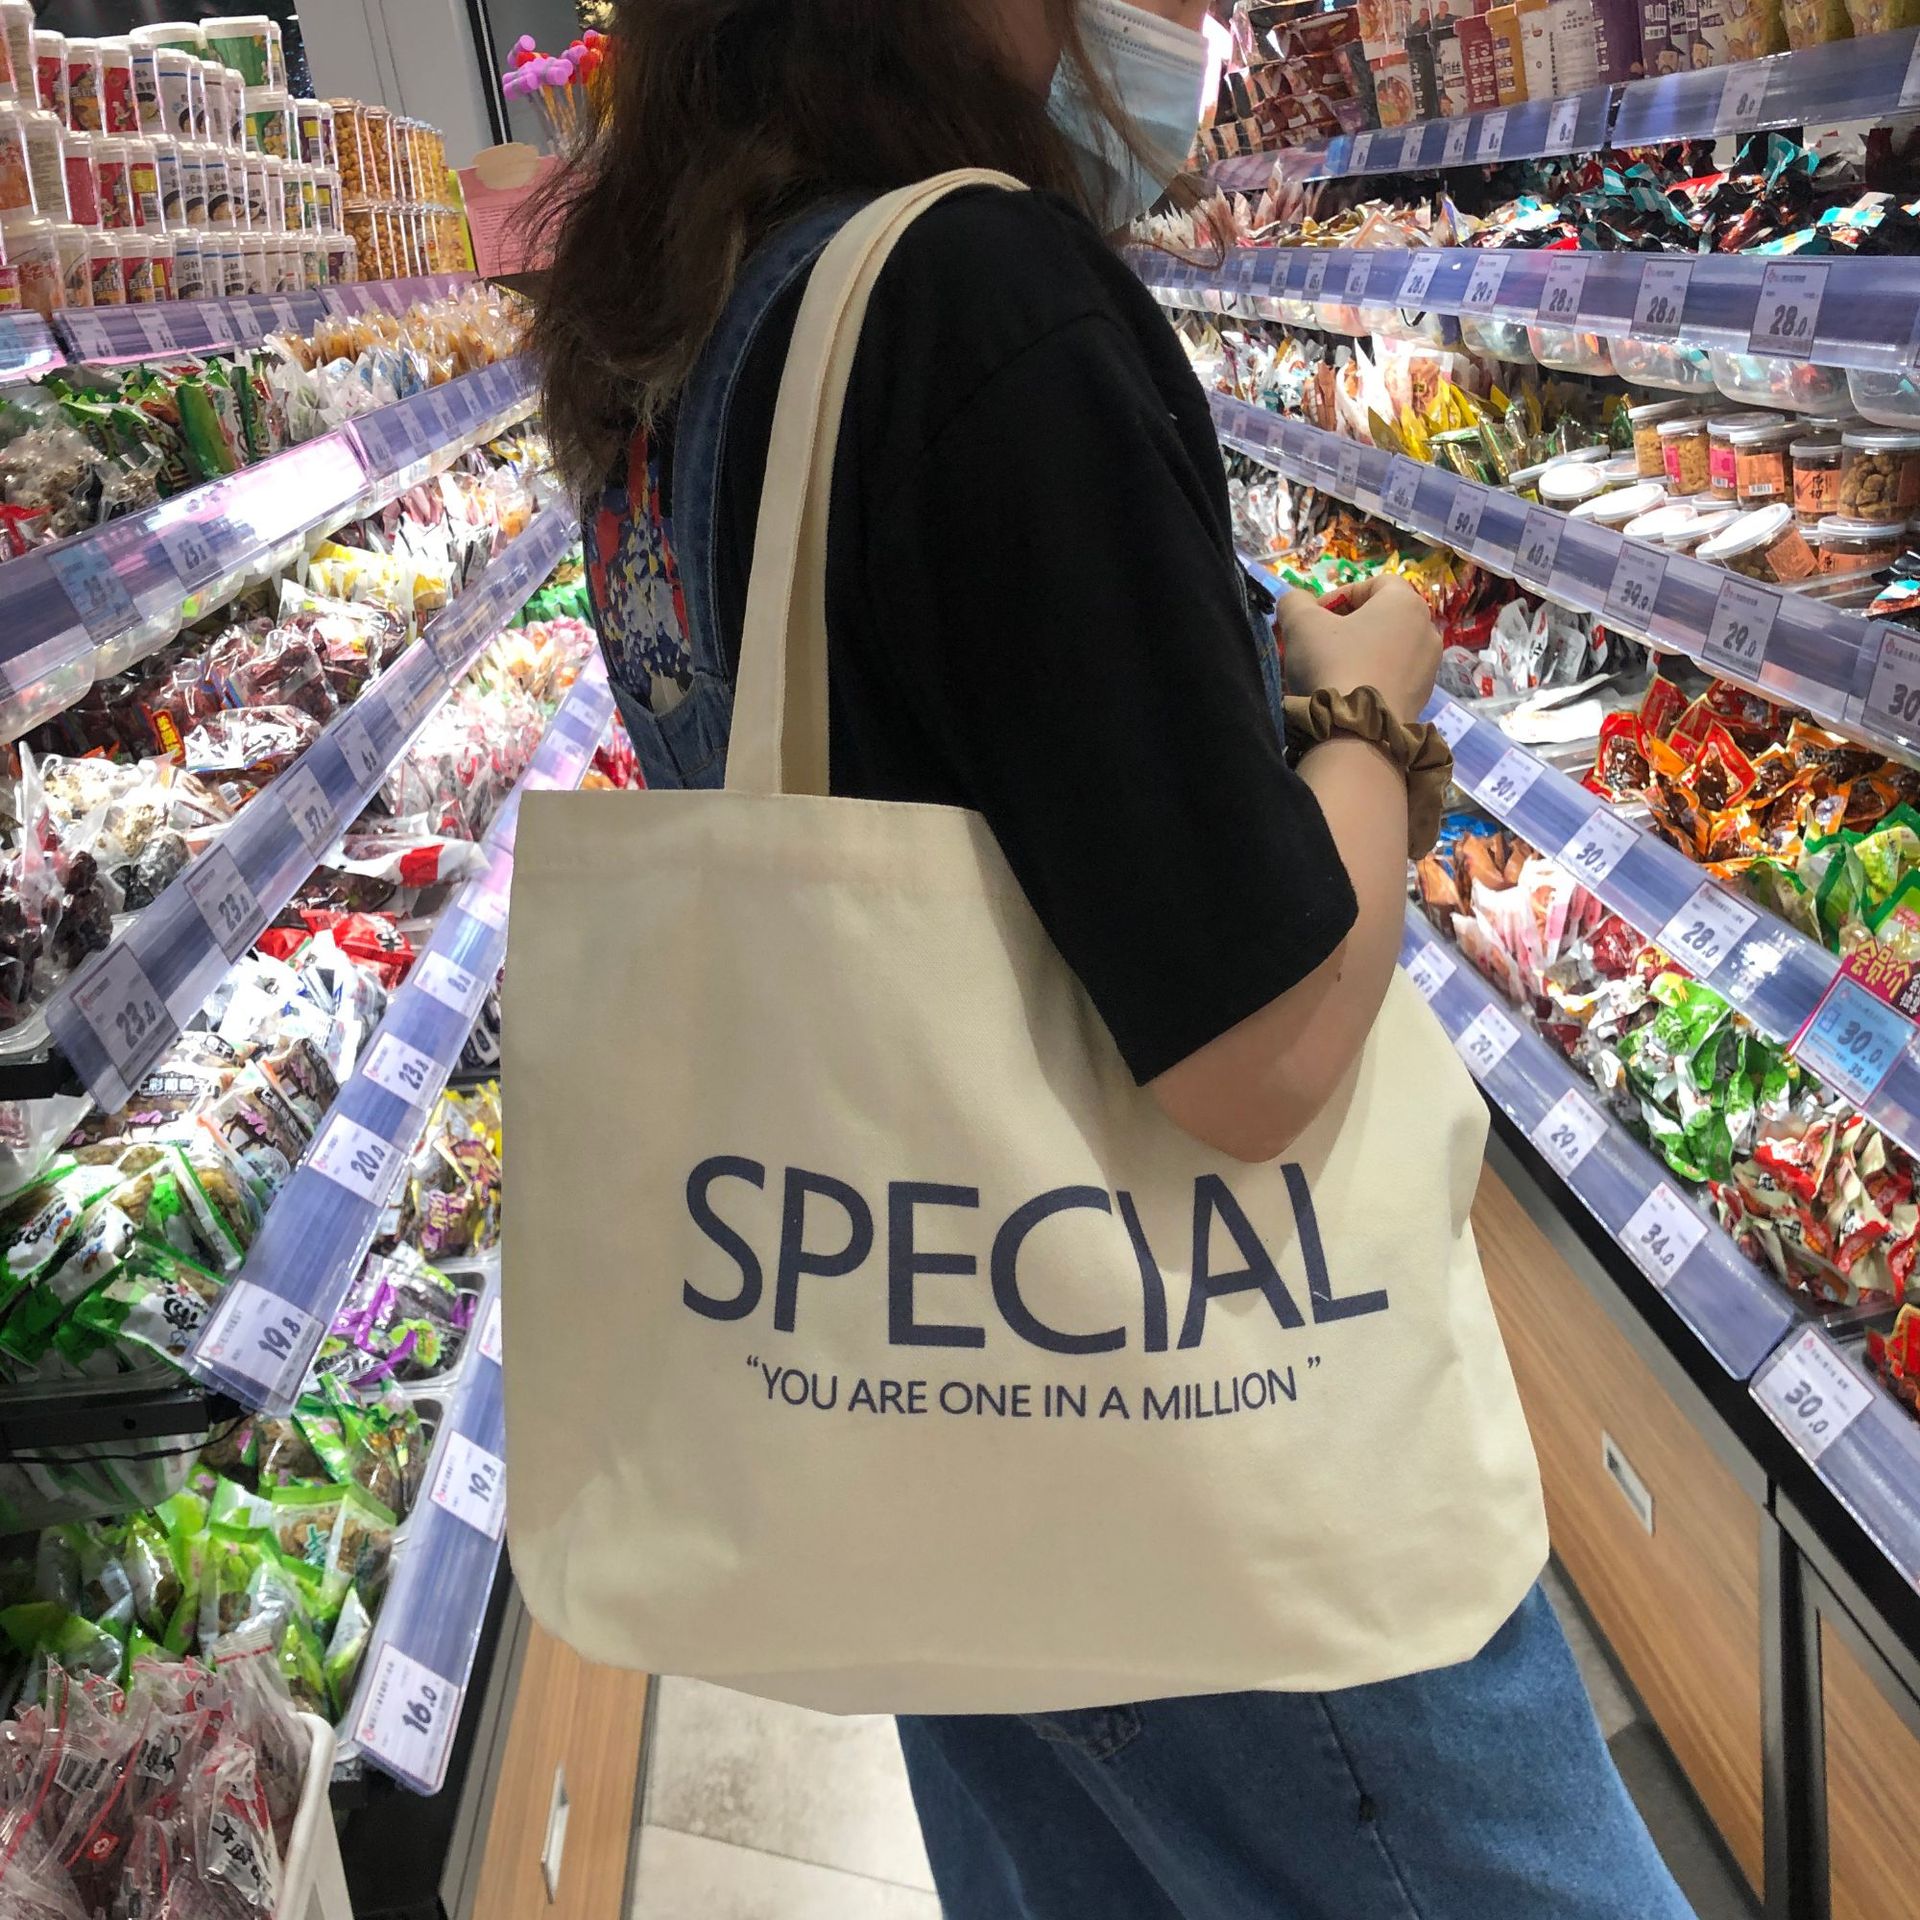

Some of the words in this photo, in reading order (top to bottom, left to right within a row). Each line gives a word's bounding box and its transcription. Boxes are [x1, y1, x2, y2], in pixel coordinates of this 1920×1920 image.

[1548, 287, 1573, 313] 28.0
[1646, 295, 1676, 323] 28.0
[1768, 304, 1808, 336] 28.0
[1722, 620, 1758, 659] 29.0
[1576, 841, 1607, 874] 30.0
[1681, 920, 1720, 959] 28.0
[1850, 939, 1912, 1000] 会员价
[1838, 1020, 1884, 1065] 30.0
[350, 1143, 386, 1182] 20.0
[682, 1154, 1389, 1355] SPECIAL
[1640, 1222, 1676, 1267] 34.0
[258, 1316, 301, 1361] 19.8
[847, 1377, 928, 1414] ARE
[939, 1380, 1031, 1419] ONE
[1043, 1382, 1087, 1419] IN
[1099, 1382, 1130, 1420] A
[1784, 1379, 1830, 1434] 30.0
[468, 1463, 497, 1502] 19.8
[402, 1685, 437, 1735] 16.0
